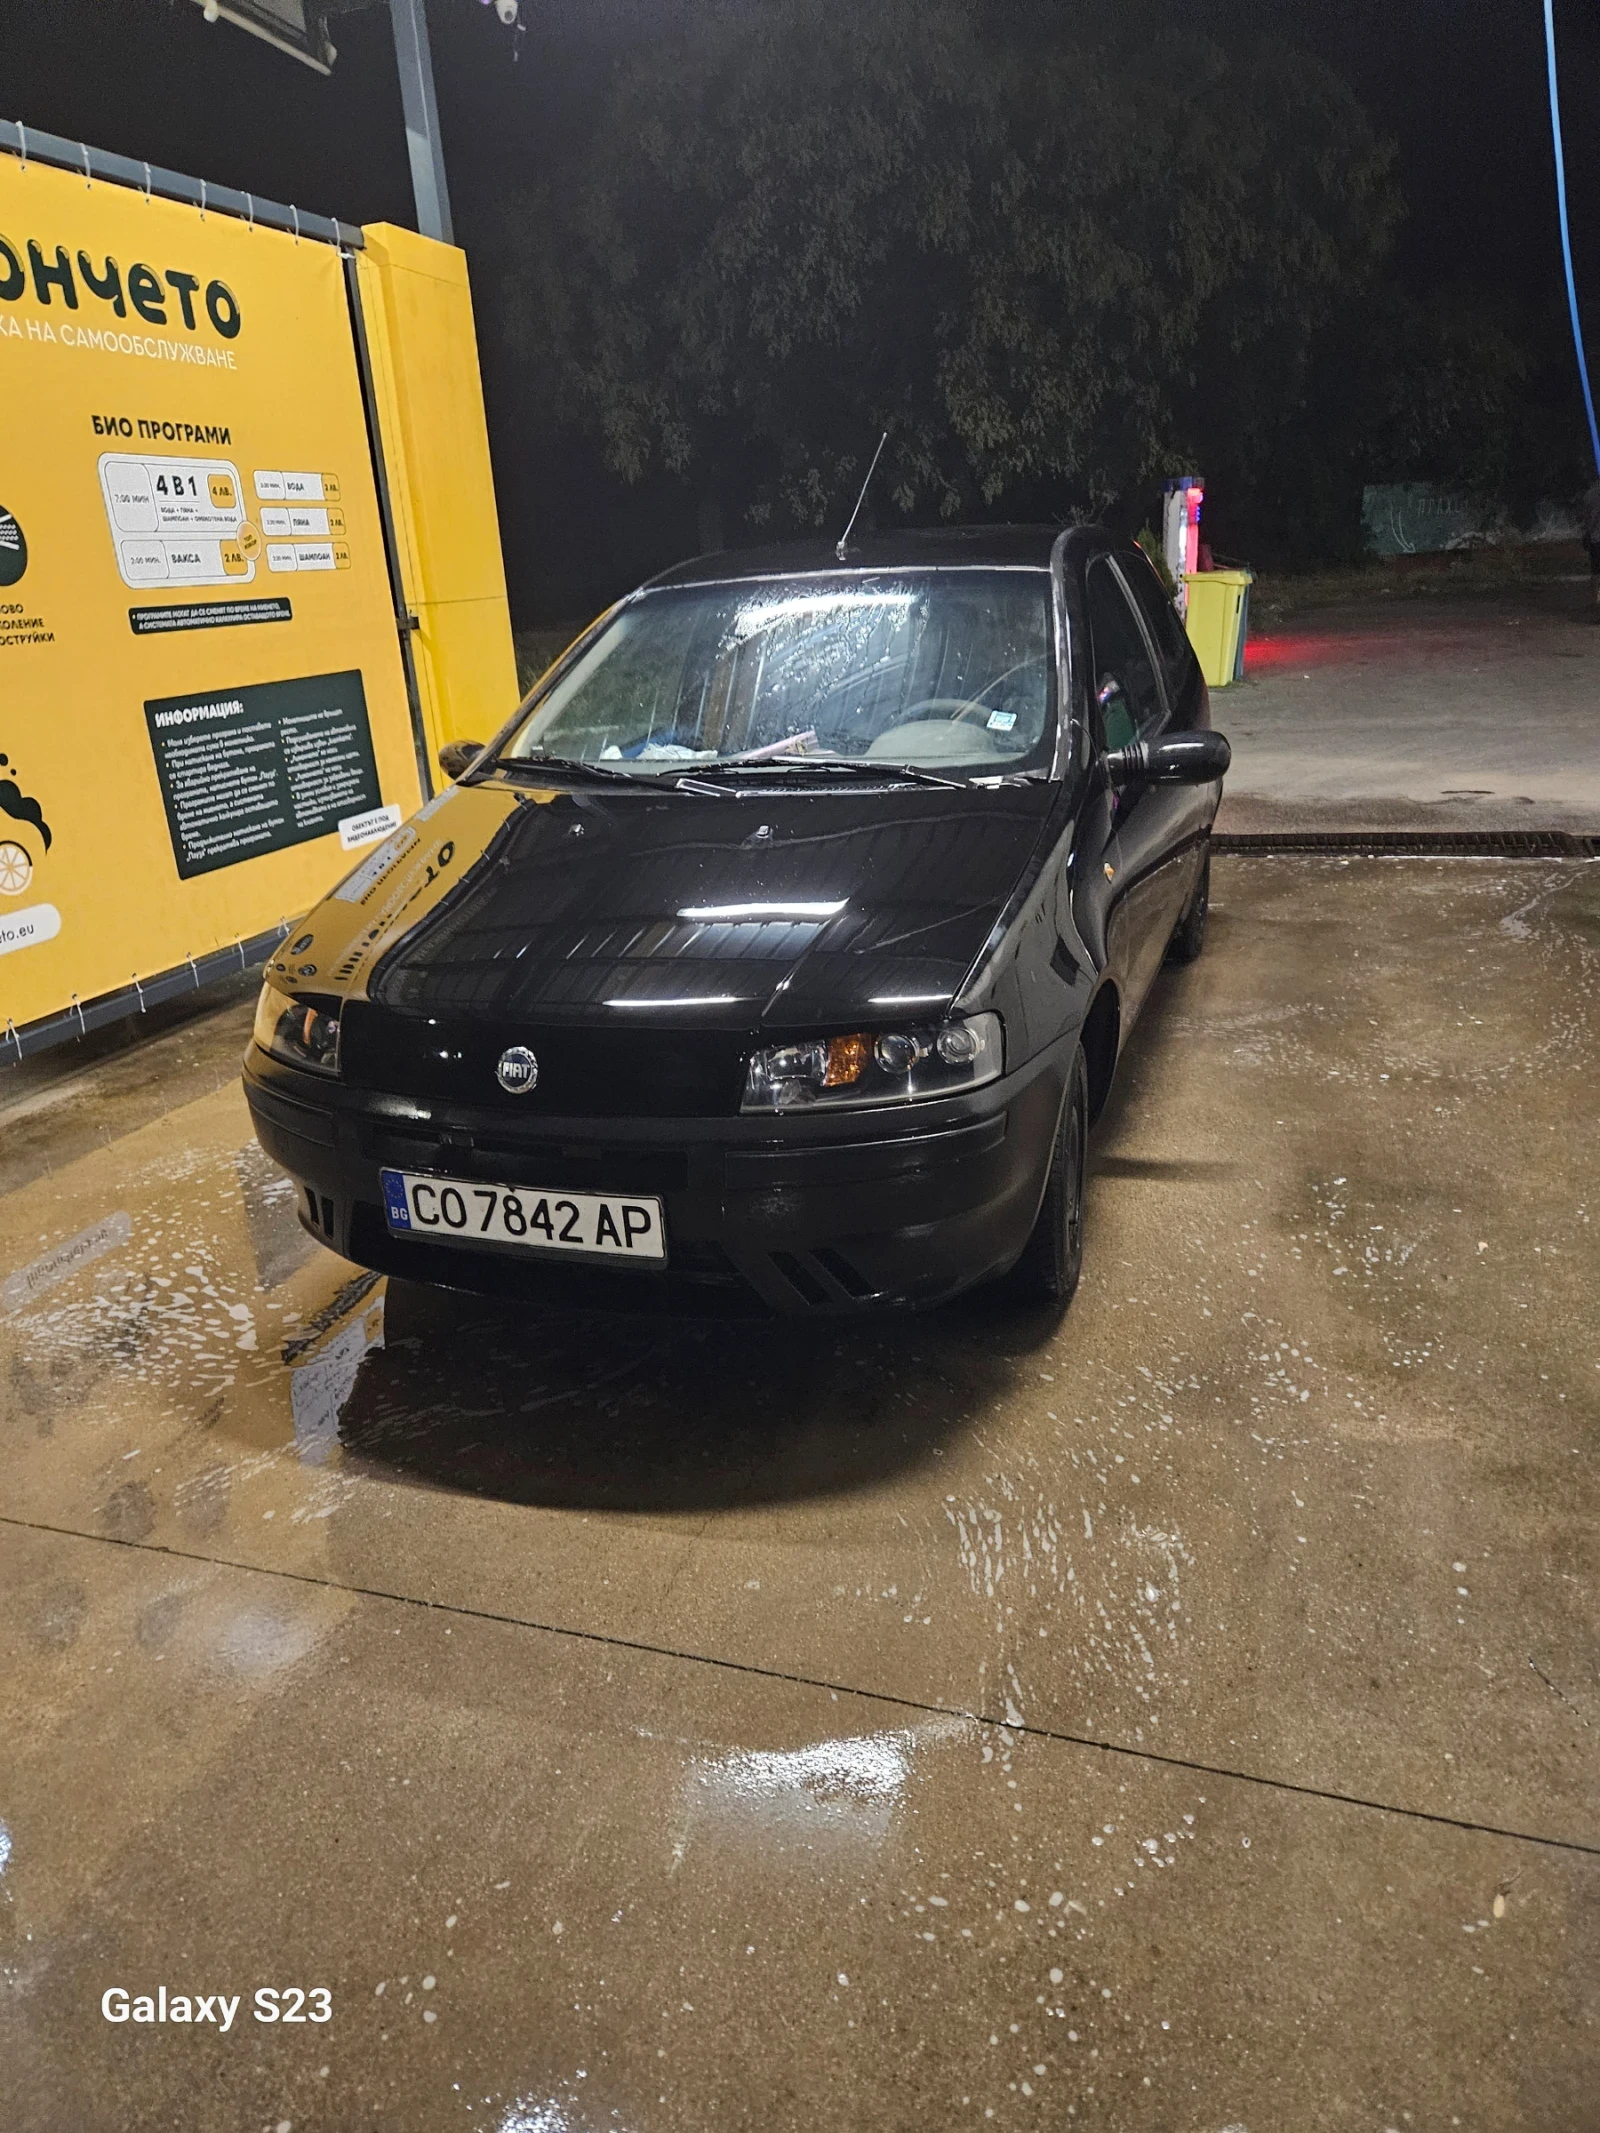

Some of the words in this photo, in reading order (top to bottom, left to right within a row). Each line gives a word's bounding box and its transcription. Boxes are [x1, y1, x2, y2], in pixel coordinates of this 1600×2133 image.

[25, 317, 58, 344] НА
[60, 323, 238, 371] САМООБСЛУЖВАНЕ
[91, 414, 134, 438] БИО
[137, 418, 232, 446] ПРОГРАМИ
[286, 482, 306, 492] ВОДА
[171, 553, 202, 564] ВАКСА
[298, 552, 331, 562] ШАМПОАН
[154, 700, 245, 728] ИНФОРМАЦИЯ:
[502, 1061, 530, 1080] FIAT
[390, 1205, 409, 1222] BG
[473, 1190, 584, 1244] 7842
[595, 1203, 652, 1249] AP
